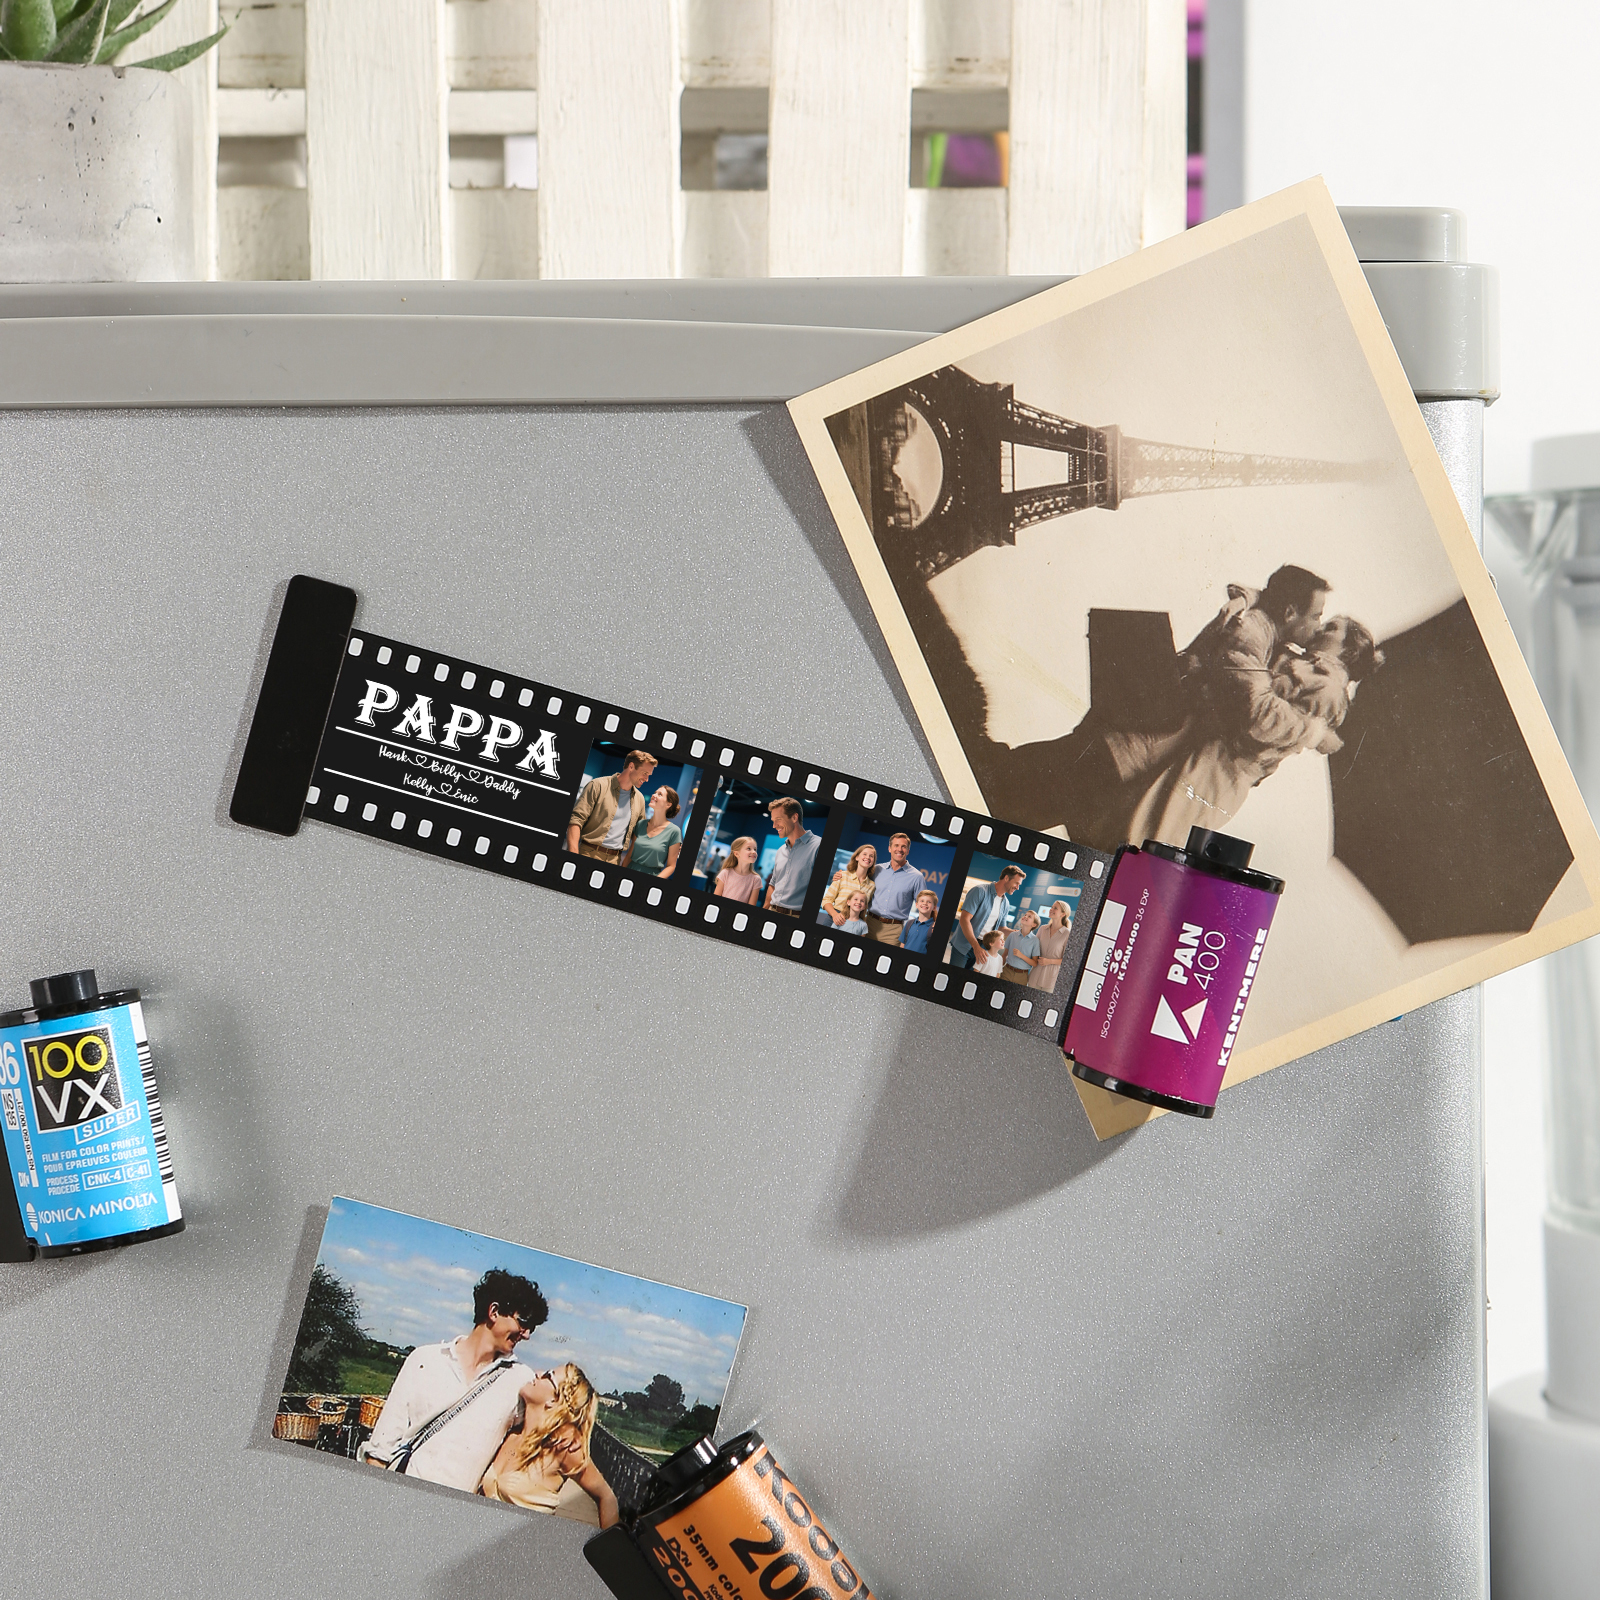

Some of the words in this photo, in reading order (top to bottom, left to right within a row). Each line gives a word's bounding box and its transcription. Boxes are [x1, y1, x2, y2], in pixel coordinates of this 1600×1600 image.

[354, 679, 561, 780] PAPPA
[378, 744, 409, 763] Hank
[431, 760, 464, 784] Billy
[483, 775, 522, 800] Daddy
[402, 773, 434, 796] Kelly
[1139, 888, 1150, 906] EXP
[1135, 907, 1145, 921] 36
[1102, 947, 1113, 969] 800
[1109, 948, 1123, 975] 36
[1167, 921, 1204, 985] PAN
[1193, 930, 1226, 991] 400
[1117, 970, 1126, 981] K
[1217, 927, 1268, 1067] KENTMERE
[28, 1035, 108, 1081] 100
[36, 1073, 118, 1123] VX
[82, 1107, 136, 1139] SUPER
[41, 1152, 59, 1163] FILM
[60, 1149, 78, 1160] FOR
[79, 1143, 110, 1157] COLOR
[110, 1135, 145, 1151] PRINTS/
[43, 1162, 64, 1174] POUR
[65, 1155, 110, 1171] EPREUVES
[111, 1146, 148, 1161] COULEUR
[46, 1173, 79, 1187] PROCESS
[87, 1170, 122, 1187] CNK-4
[126, 1164, 149, 1179] C-41
[47, 1183, 81, 1196] PROCEDE
[37, 1206, 86, 1224] KONICA
[89, 1192, 158, 1218] MINOLTA
[683, 1524, 719, 1572] 35mm
